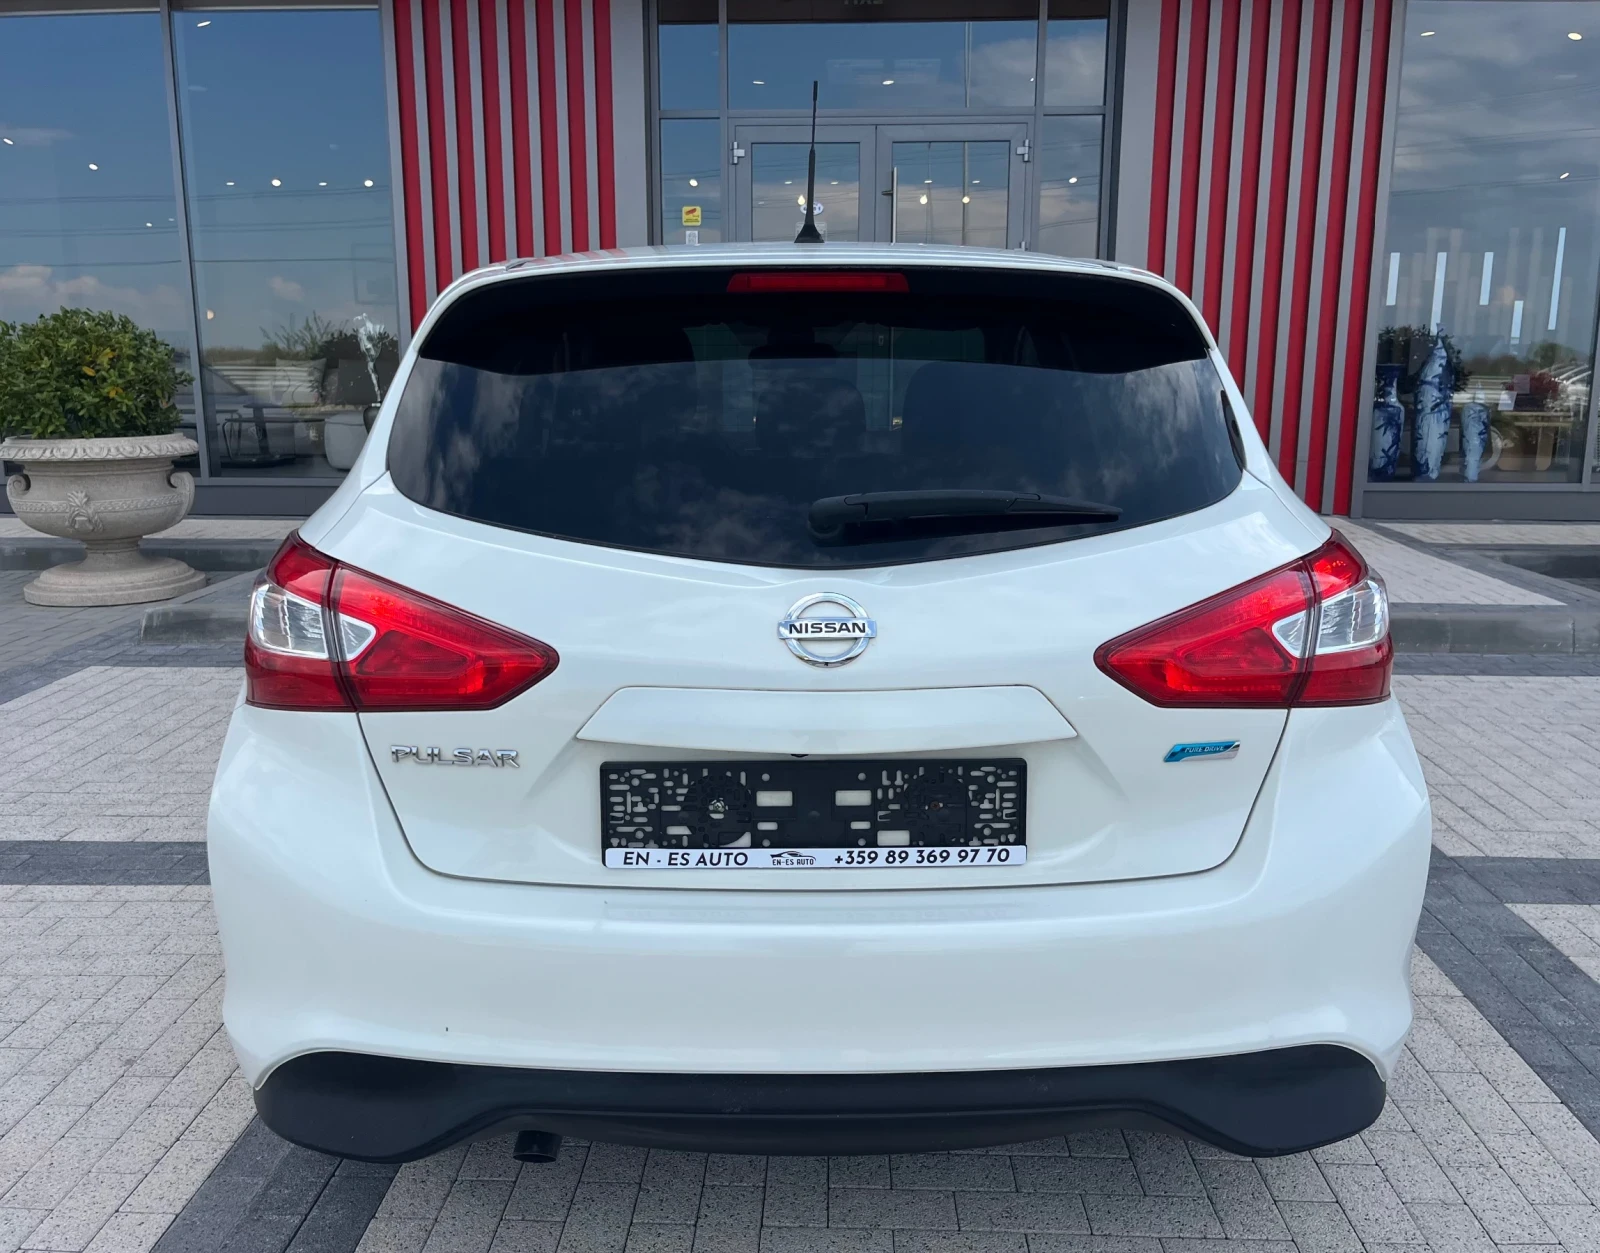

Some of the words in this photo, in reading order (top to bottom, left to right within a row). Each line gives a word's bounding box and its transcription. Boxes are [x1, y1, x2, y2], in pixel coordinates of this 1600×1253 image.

[789, 622, 866, 634] NISSAN
[391, 745, 520, 768] PULSAR
[623, 852, 650, 866] EN
[667, 852, 690, 866] ES
[695, 852, 749, 867] AUTO
[772, 858, 794, 866] EN-ES
[796, 858, 815, 866] AUTO
[834, 850, 879, 865] +359
[884, 850, 909, 865] 89
[915, 850, 950, 865] 369
[957, 848, 981, 863] 97
[986, 848, 1010, 863] 70
